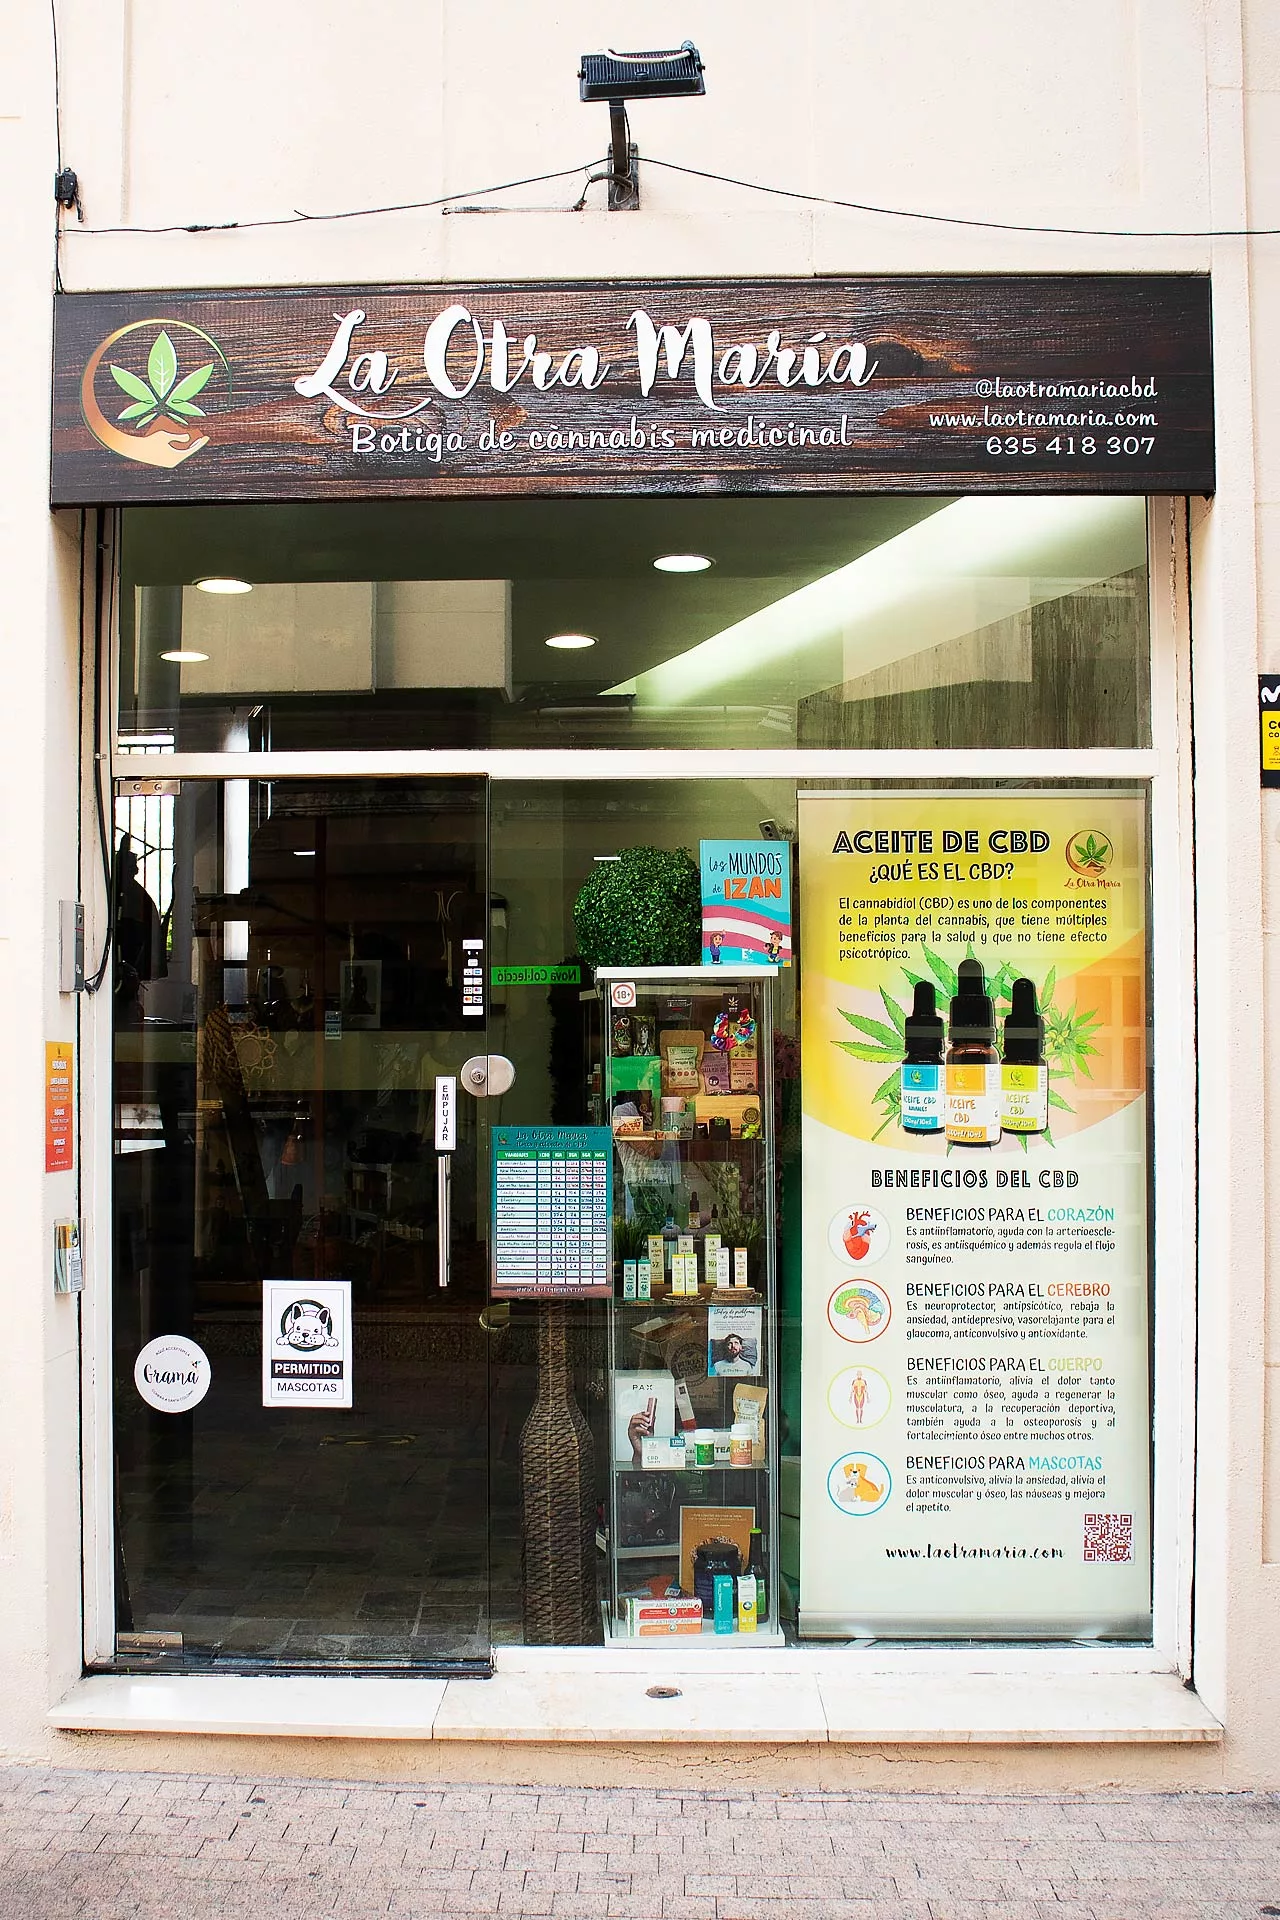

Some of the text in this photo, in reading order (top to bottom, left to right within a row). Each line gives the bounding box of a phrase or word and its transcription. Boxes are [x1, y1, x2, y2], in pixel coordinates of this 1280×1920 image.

[294, 304, 879, 419] La Otra María
[975, 377, 1158, 400] @laotramariacbd
[929, 409, 1159, 428] www.laotramaria.com
[351, 414, 854, 462] Botiga de cànnabis medicinal
[986, 435, 1156, 456] 635 418 307
[831, 829, 1051, 854] ACEITE DE CBD
[728, 852, 782, 876] MUNDOS
[869, 858, 1015, 884] ¿QUÉ ES EL CBD?
[712, 876, 782, 900] de IZAN
[1064, 878, 1077, 889] La
[1077, 878, 1096, 888] Otra
[840, 896, 1107, 912] El cannabidiol (CBD) es uno de los componentes
[839, 913, 1107, 929] de la planta del cannabis, que tiene múltiples
[839, 930, 1108, 946] beneficios para la salud y que no tiene efecto
[839, 946, 911, 962] psicotrópico.
[616, 990, 631, 1000] 18+
[923, 1094, 937, 1104] CBD
[441, 1084, 451, 1142] EMPUJAR
[1009, 1105, 1025, 1115] CBD
[953, 1113, 970, 1123] CBD
[871, 1169, 1079, 1189] BENEFICIOS DEL CBD
[906, 1205, 1114, 1223] BENEFICIOS PARA EL CORAZÓN
[907, 1225, 1116, 1239] Es antiinflamatorio, ayuda con la arterioescle-
[906, 1239, 1116, 1253] rosis, es antiisquémico además regula el flujo
[905, 1253, 954, 1266] sanguíneo.
[906, 1282, 1111, 1298] BENEFICIOS PARA EL CEREBRO
[906, 1300, 1115, 1313] Es neuroprotector, antipsicótico, rebaja la
[906, 1314, 1115, 1327] ansiedad, antidepresivo, vasorelajante para el
[906, 1327, 1088, 1341] glaucoma, anticonvulsivo antioxidante.
[273, 1363, 340, 1376] PERMITIDO
[907, 1357, 1104, 1373] BENEFICIOS PARA EL CUERPO
[143, 1363, 199, 1386] Grama
[906, 1375, 1116, 1387] Es antiinflamatorio, alivia el dolor tanto
[276, 1381, 337, 1394] MASCOTAS
[632, 1383, 653, 1391] PAX
[906, 1389, 1116, 1402] muscular como óseo, ayuda regenerar la
[906, 1402, 1116, 1416] musculatura, la recuperación deportiva,
[906, 1416, 1116, 1429] también ayuda la osteoporosis al
[906, 1430, 1094, 1441] fortalecimiento óseo entre muchos otros.
[715, 1446, 731, 1454] TEA
[906, 1455, 1102, 1471] BENEFICIOS PARA MASCOTAS
[906, 1474, 1106, 1487] Es anticonvulsivo, alivia la ansiedad, alivia el
[905, 1488, 1106, 1501] dolor muscular óseo, las náuseas mejora
[905, 1502, 952, 1514] el apetito.
[885, 1542, 1063, 1559] www.laotramaria.com
